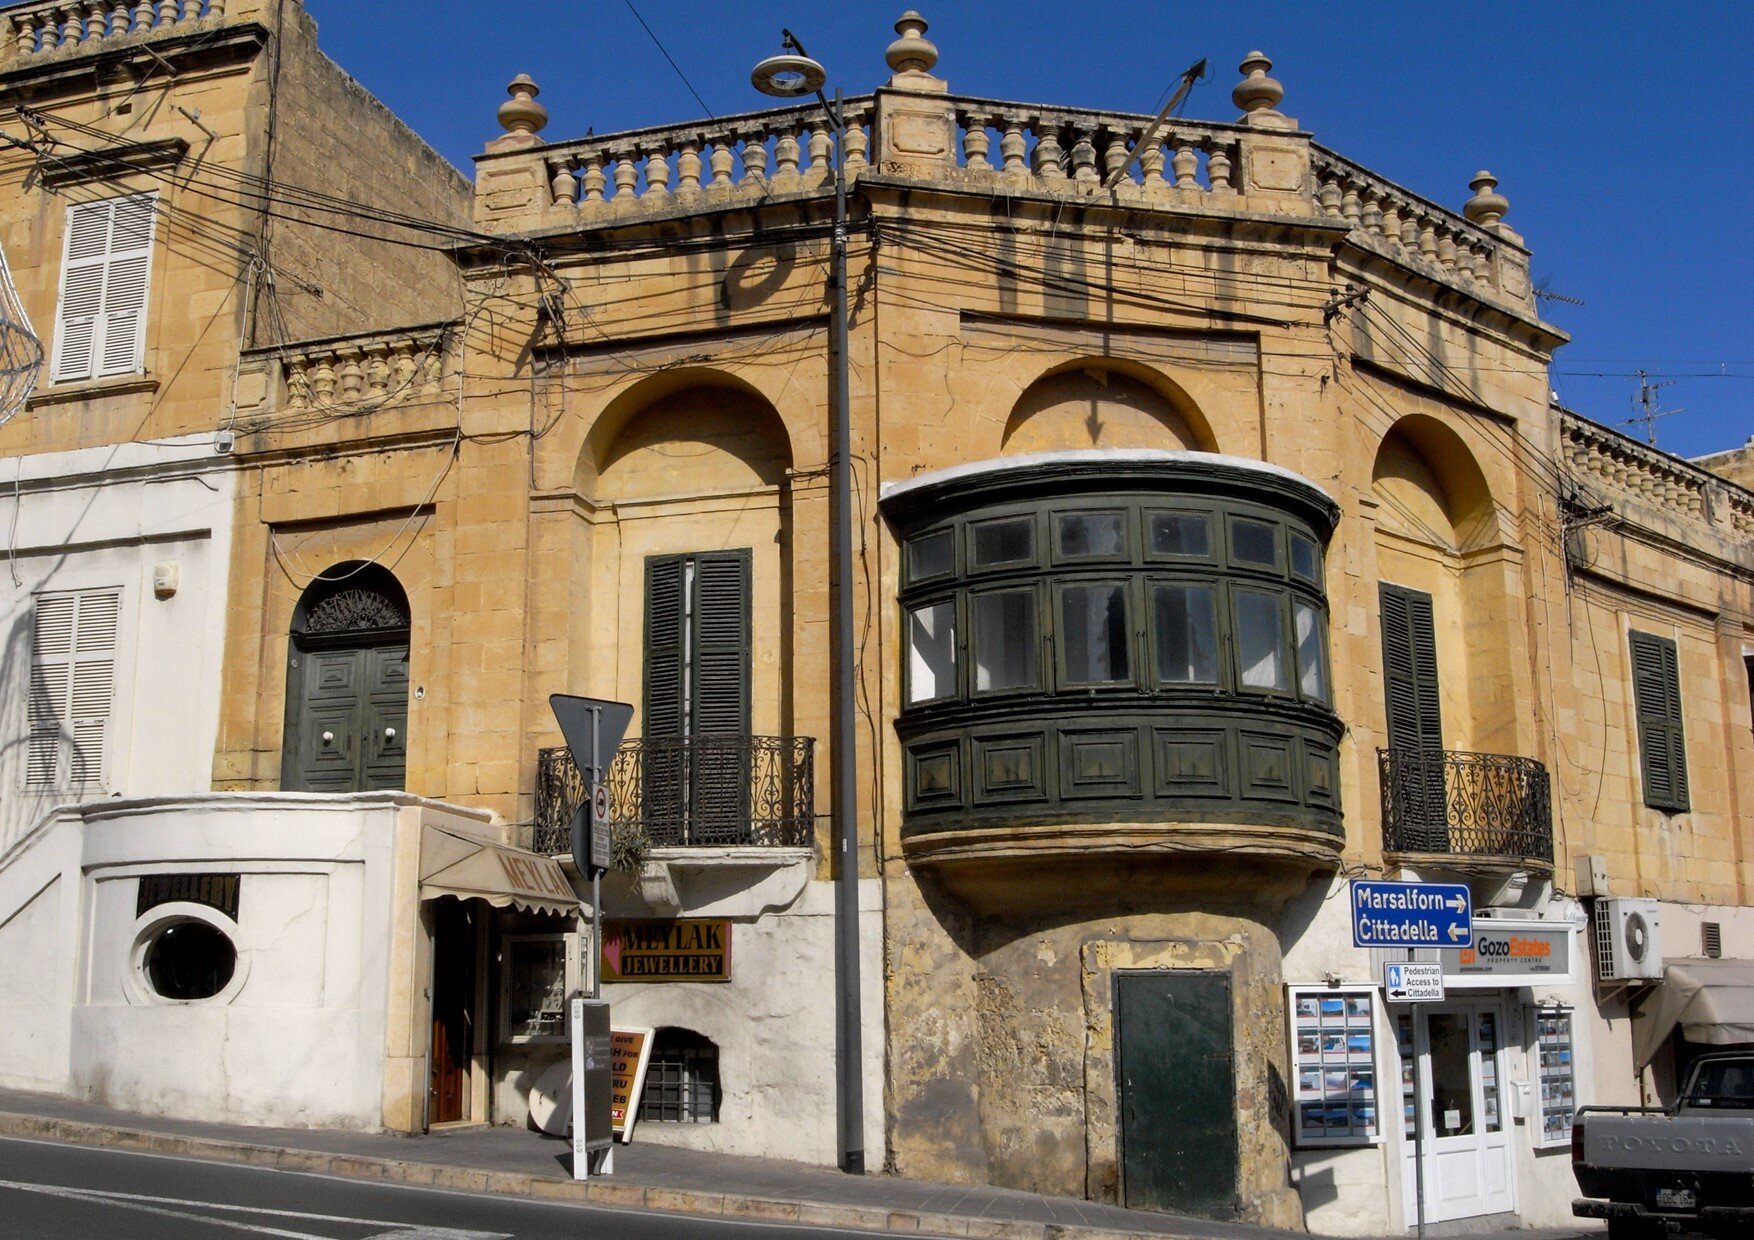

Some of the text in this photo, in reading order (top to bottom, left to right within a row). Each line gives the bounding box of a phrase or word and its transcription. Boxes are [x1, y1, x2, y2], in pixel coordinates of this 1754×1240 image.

[1357, 888, 1444, 909] Marsalforn
[622, 924, 722, 950] MEYLAK
[624, 956, 720, 974] JEWELLERY
[1404, 966, 1440, 975] Pedestrian
[1406, 977, 1440, 986] Access to
[1407, 988, 1440, 997] Cittadella
[615, 1036, 634, 1044] GIVE
[623, 1050, 639, 1058] FOR
[1599, 1134, 1743, 1155] TOYOTA
